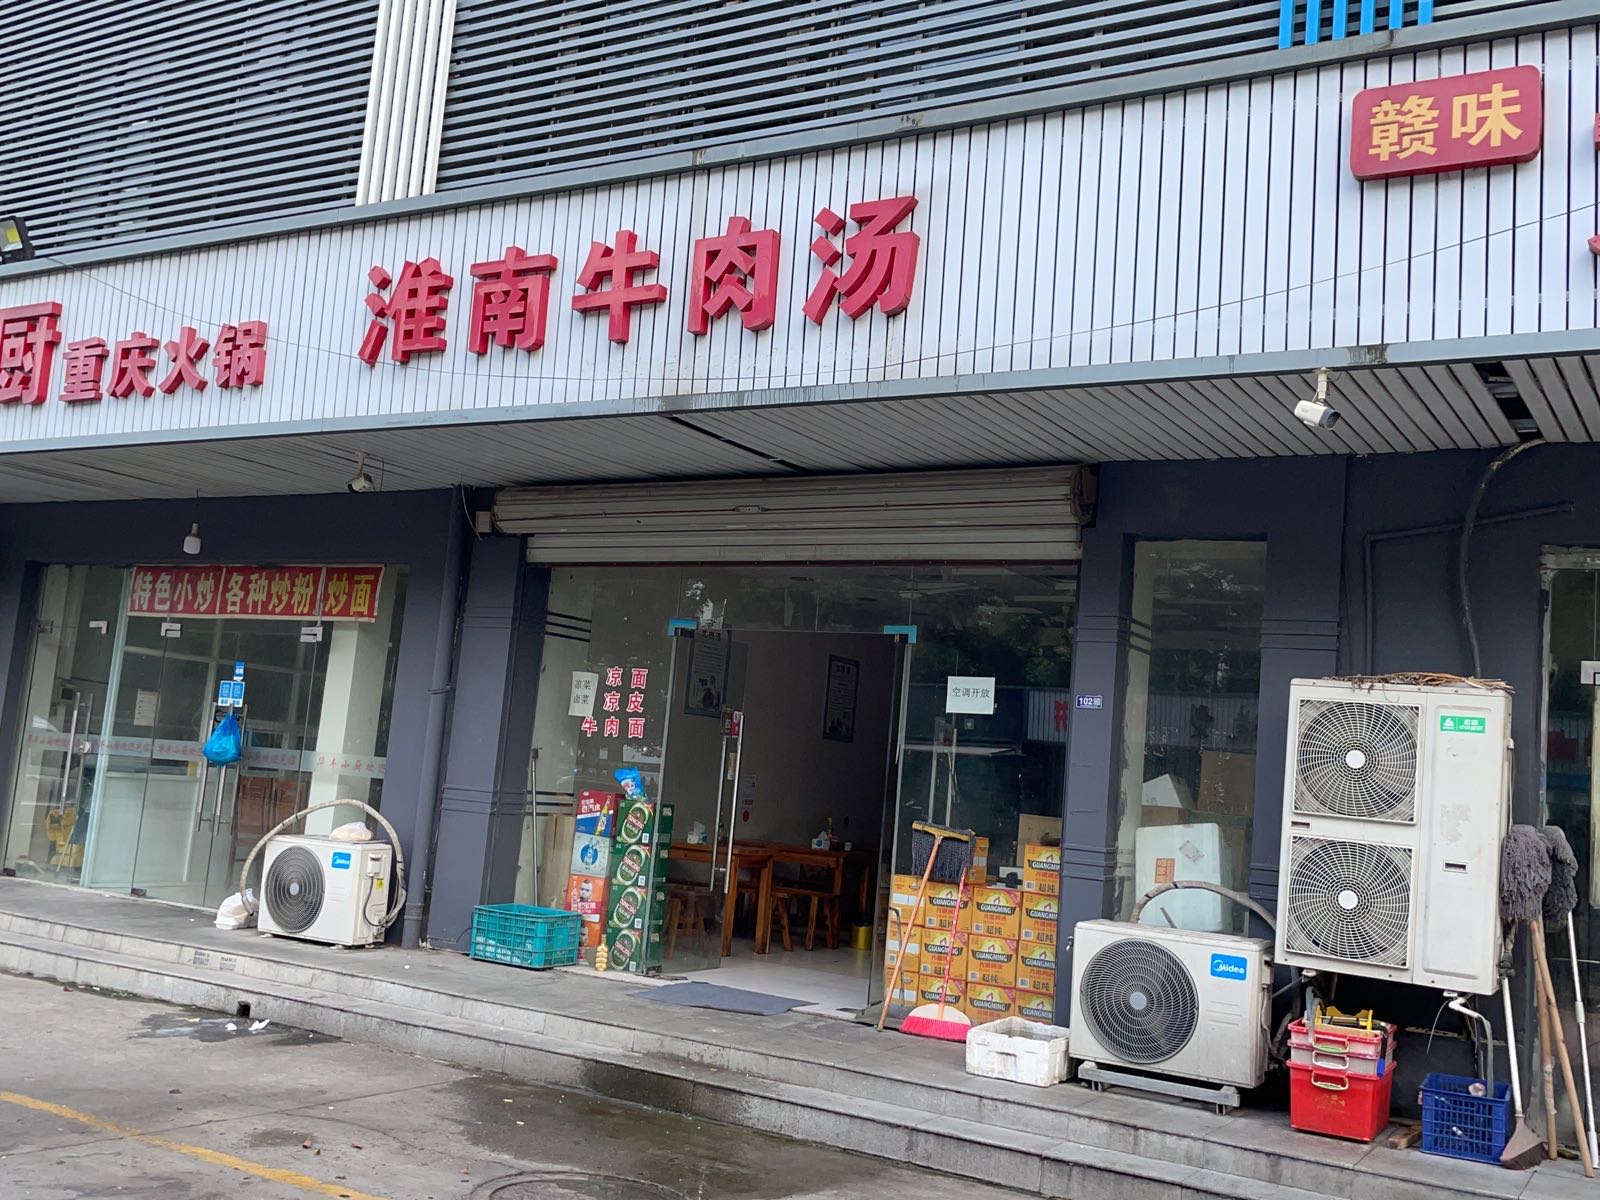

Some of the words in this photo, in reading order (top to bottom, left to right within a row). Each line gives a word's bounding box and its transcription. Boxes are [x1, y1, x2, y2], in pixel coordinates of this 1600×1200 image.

[1368, 82, 1523, 162] 赣味
[357, 194, 920, 367] 淮南牛肉汤
[59, 319, 268, 403] 重庆火锅
[133, 571, 215, 613] 特色小炒
[225, 571, 314, 615] 各种炒粉
[324, 573, 375, 616] 炒面
[605, 666, 648, 689] 凉面
[602, 690, 644, 713] 凉皮
[952, 686, 990, 699] 空调开放
[581, 715, 646, 739] 牛肉面
[980, 904, 1012, 914] GUANGMING
[975, 952, 1008, 962] GUANGMING
[1213, 959, 1245, 974] Midea
[973, 999, 1006, 1010] GUANGMING
